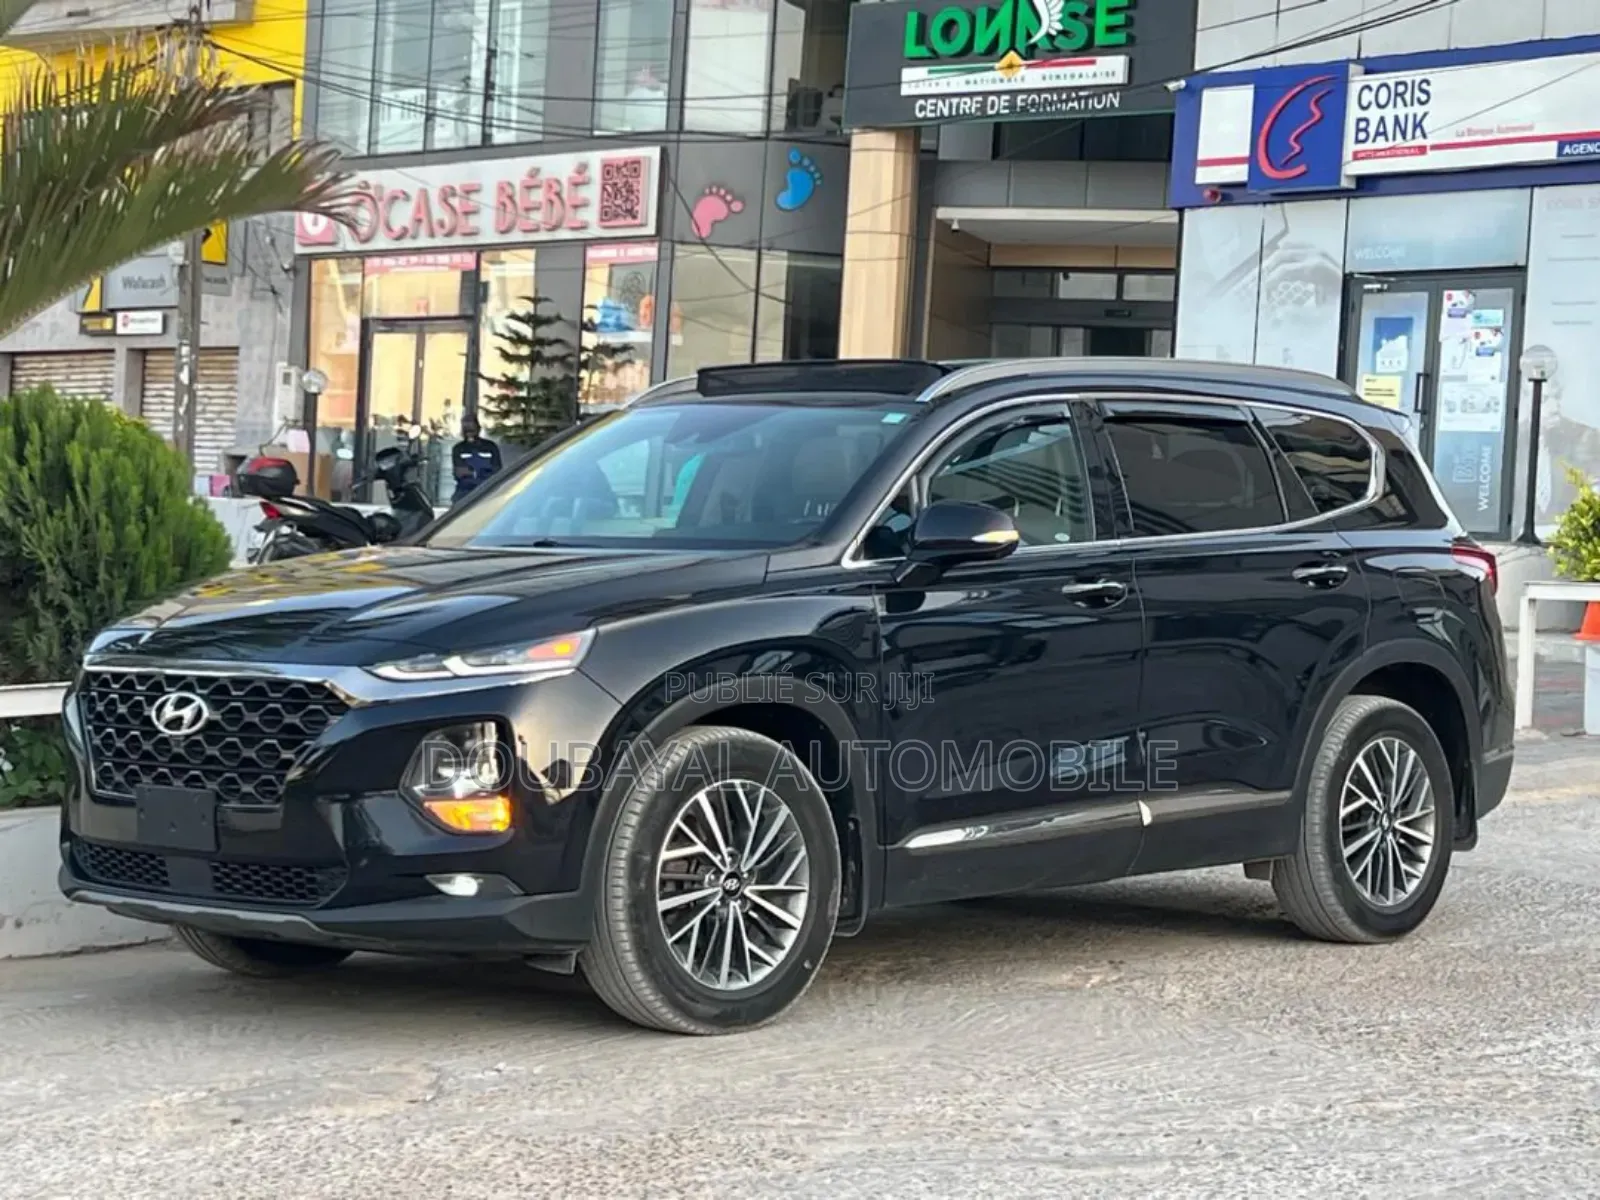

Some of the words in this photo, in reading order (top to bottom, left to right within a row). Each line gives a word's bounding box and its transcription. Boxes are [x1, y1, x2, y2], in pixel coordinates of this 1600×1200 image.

[915, 96, 983, 118] CENTRE
[986, 94, 1010, 115] DE
[1016, 91, 1120, 113] FORMATION
[1357, 78, 1431, 111] CORIS
[1354, 110, 1428, 144] BANK
[495, 161, 591, 235] BÉBÉ
